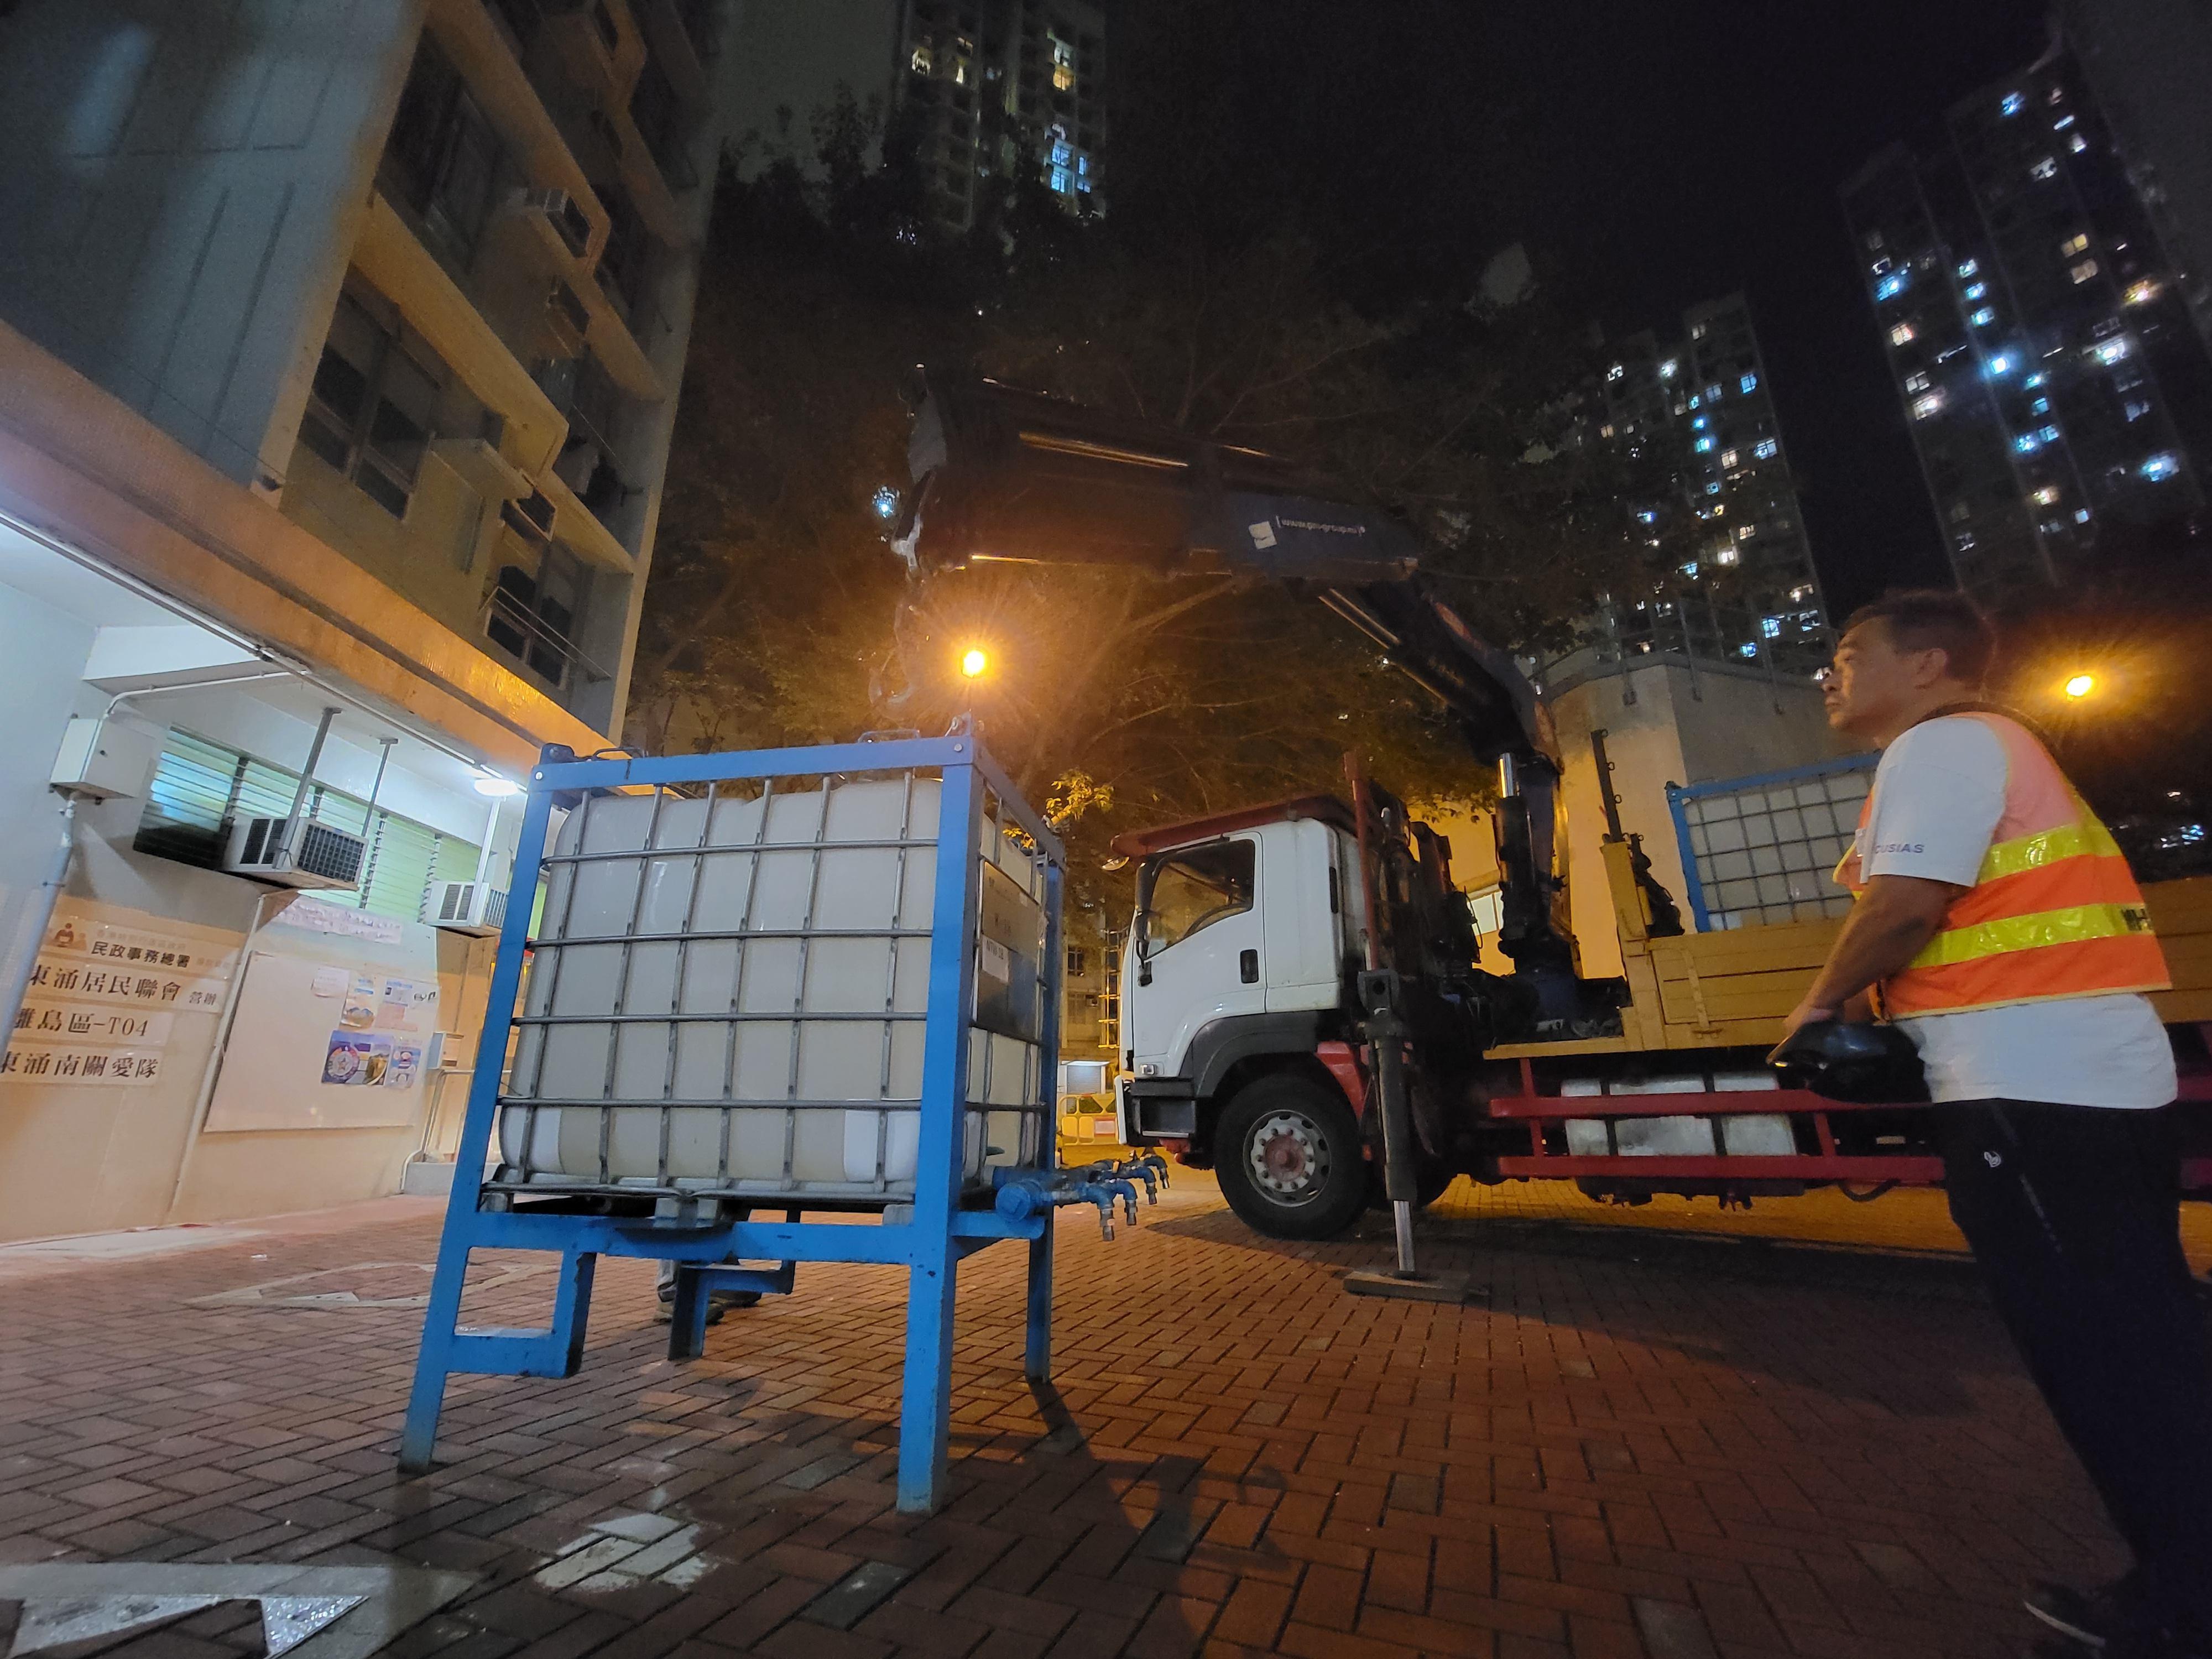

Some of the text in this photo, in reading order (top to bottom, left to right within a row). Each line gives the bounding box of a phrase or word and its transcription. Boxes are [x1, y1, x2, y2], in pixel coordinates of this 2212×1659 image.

[91, 941, 191, 968] 民政事務總署
